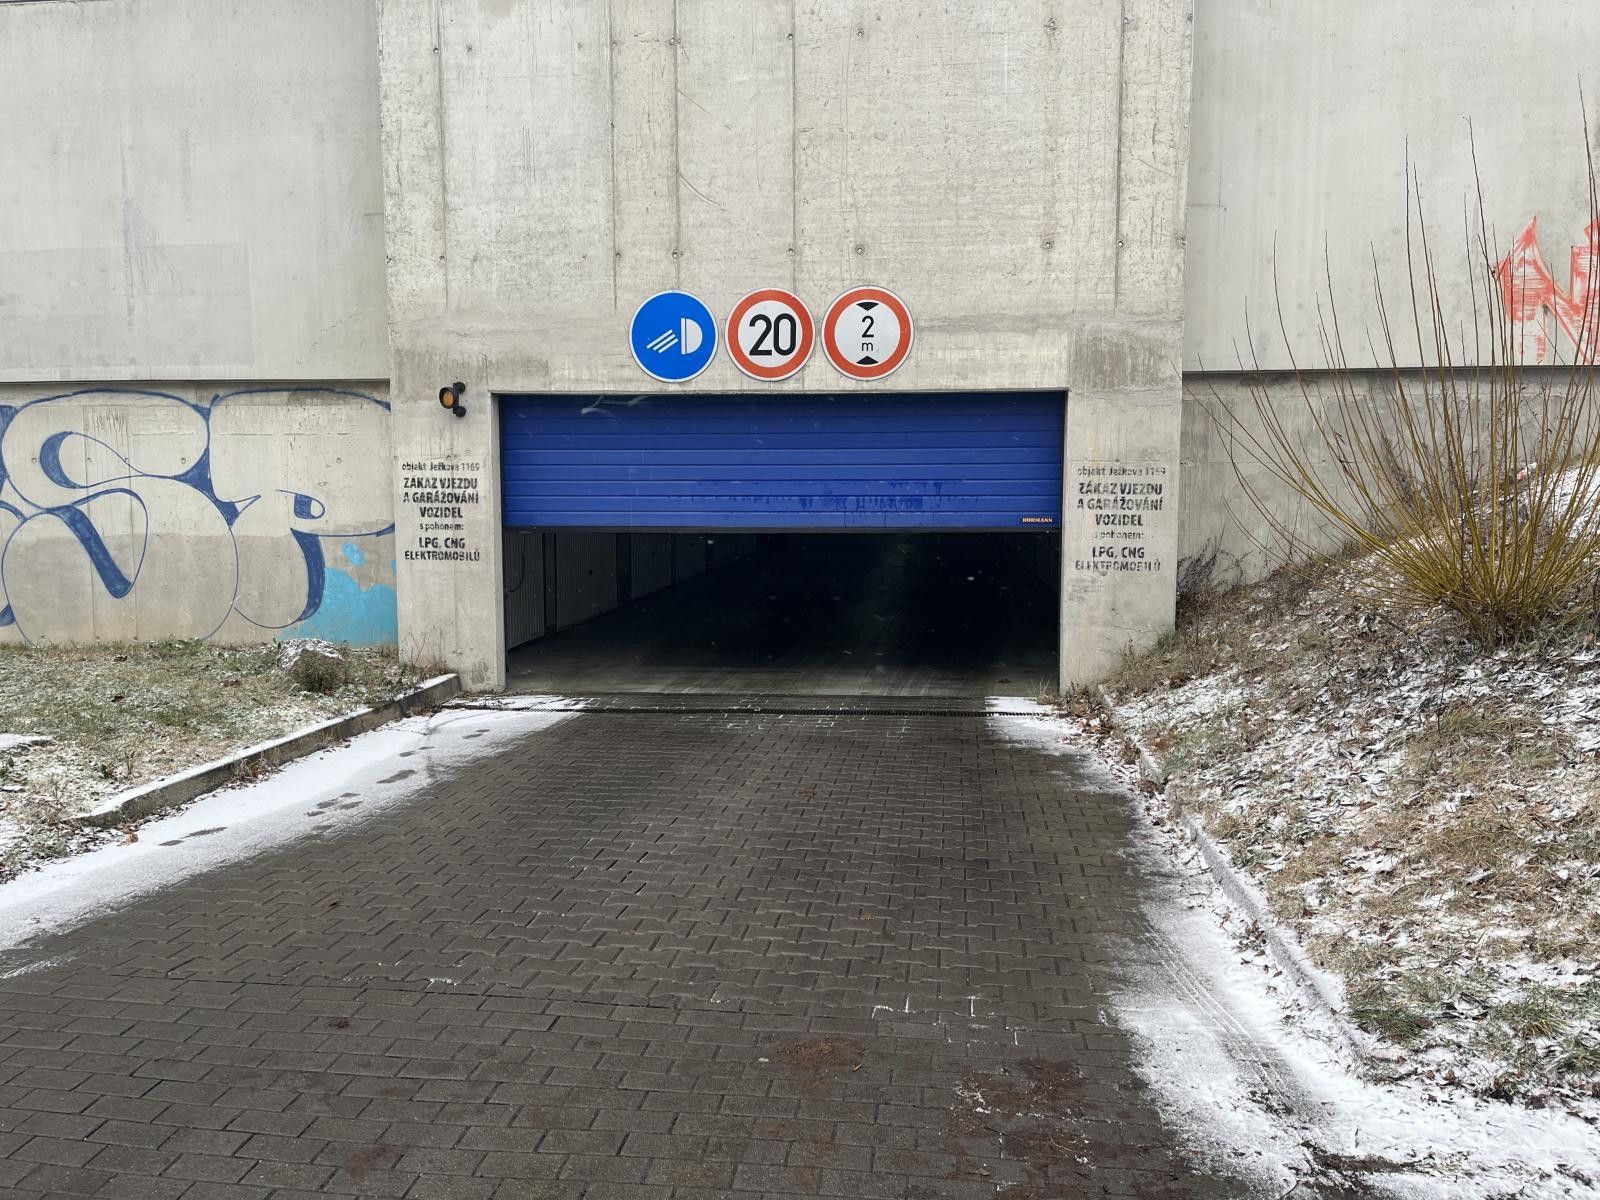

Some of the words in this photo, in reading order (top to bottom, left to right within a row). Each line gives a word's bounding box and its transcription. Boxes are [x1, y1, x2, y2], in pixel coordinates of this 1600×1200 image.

[861, 315, 875, 338] 2
[749, 313, 797, 356] 20
[861, 341, 874, 351] m
[402, 462, 426, 472] objekt
[461, 463, 480, 472] 1169
[1077, 465, 1106, 477] objekt
[439, 477, 477, 489] VJEZDU
[1079, 481, 1117, 495] ZÁKAZ
[1120, 483, 1163, 495] VJEZDU
[403, 492, 410, 503] A
[412, 490, 479, 504] GARÁŽOVÁNÍ
[1077, 498, 1084, 509] A
[1087, 496, 1163, 511] GARÁŽOVÁNÍ
[420, 507, 463, 518] VOZIDEL
[1095, 514, 1143, 526] VOZIDEL
[444, 537, 465, 549] CNG
[404, 549, 480, 562] ELEKTROMOBILŮ
[1092, 546, 1117, 559] LPG,
[1121, 546, 1145, 559] CNG
